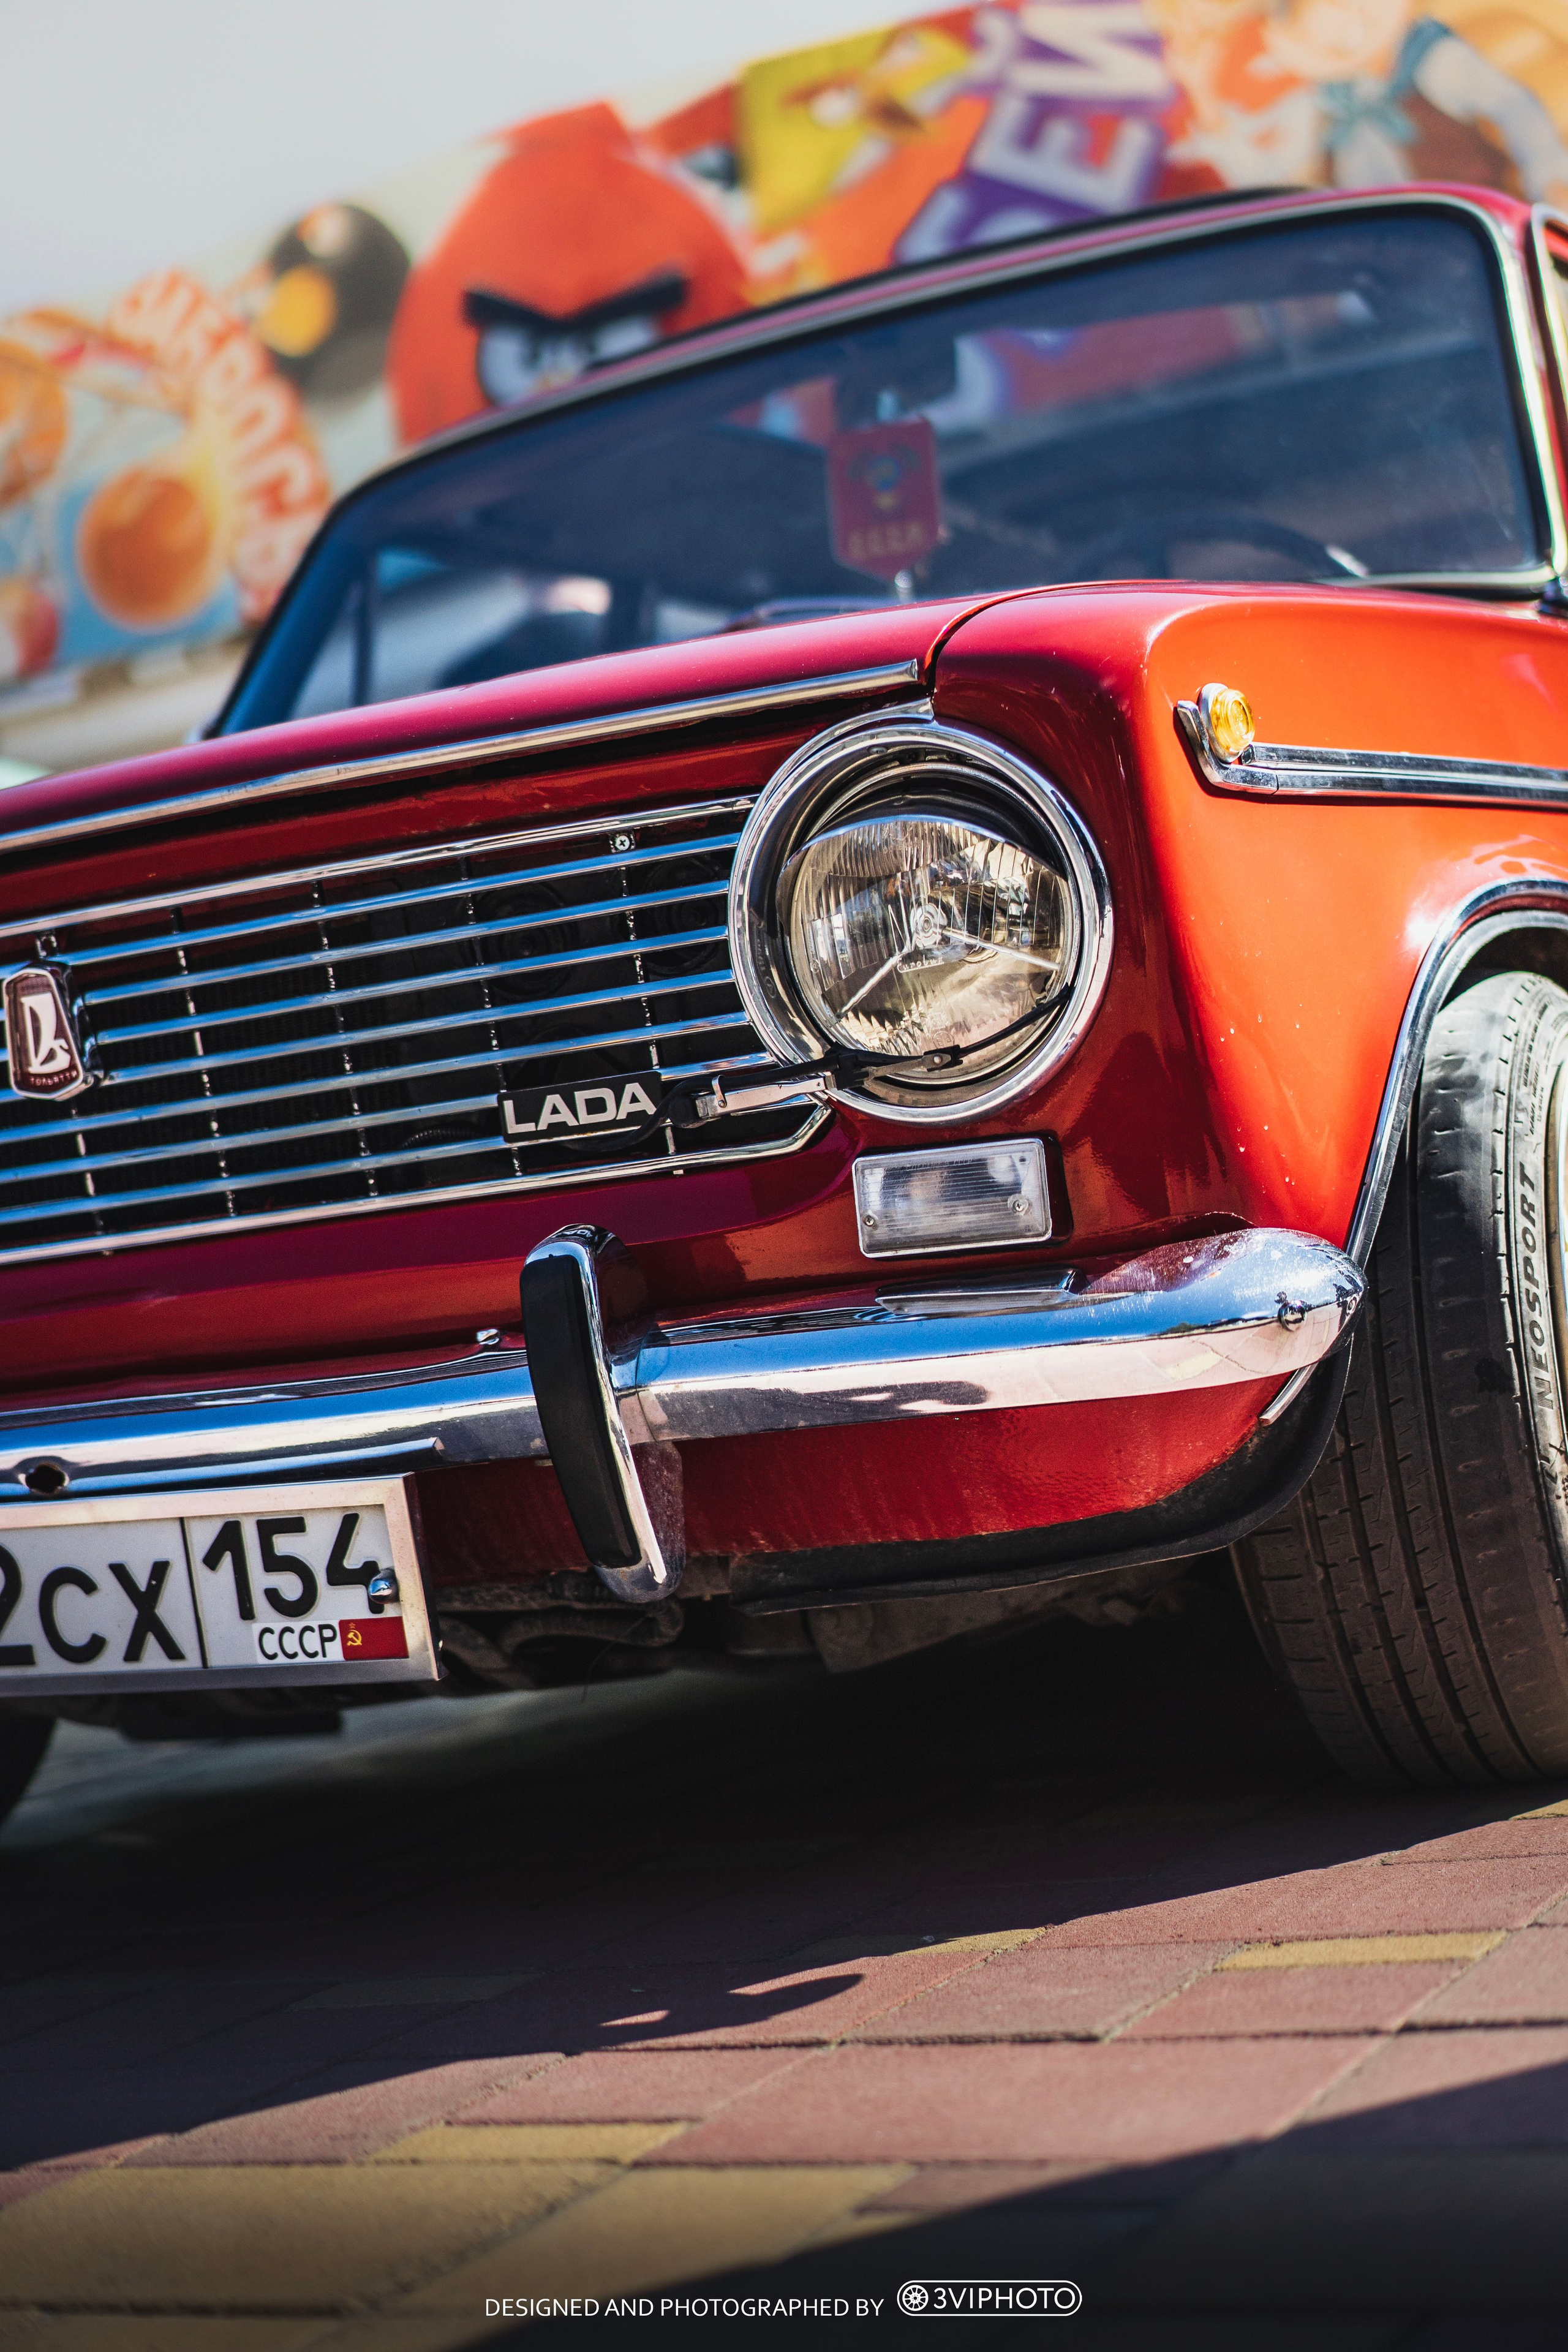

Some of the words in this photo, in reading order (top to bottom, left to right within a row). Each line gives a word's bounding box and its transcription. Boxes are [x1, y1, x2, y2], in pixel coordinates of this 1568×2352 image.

[503, 1082, 657, 1134] LADA
[1519, 1161, 1554, 1410] NEOSPORT
[203, 1513, 385, 1621] 154
[258, 1624, 337, 1660] СССР
